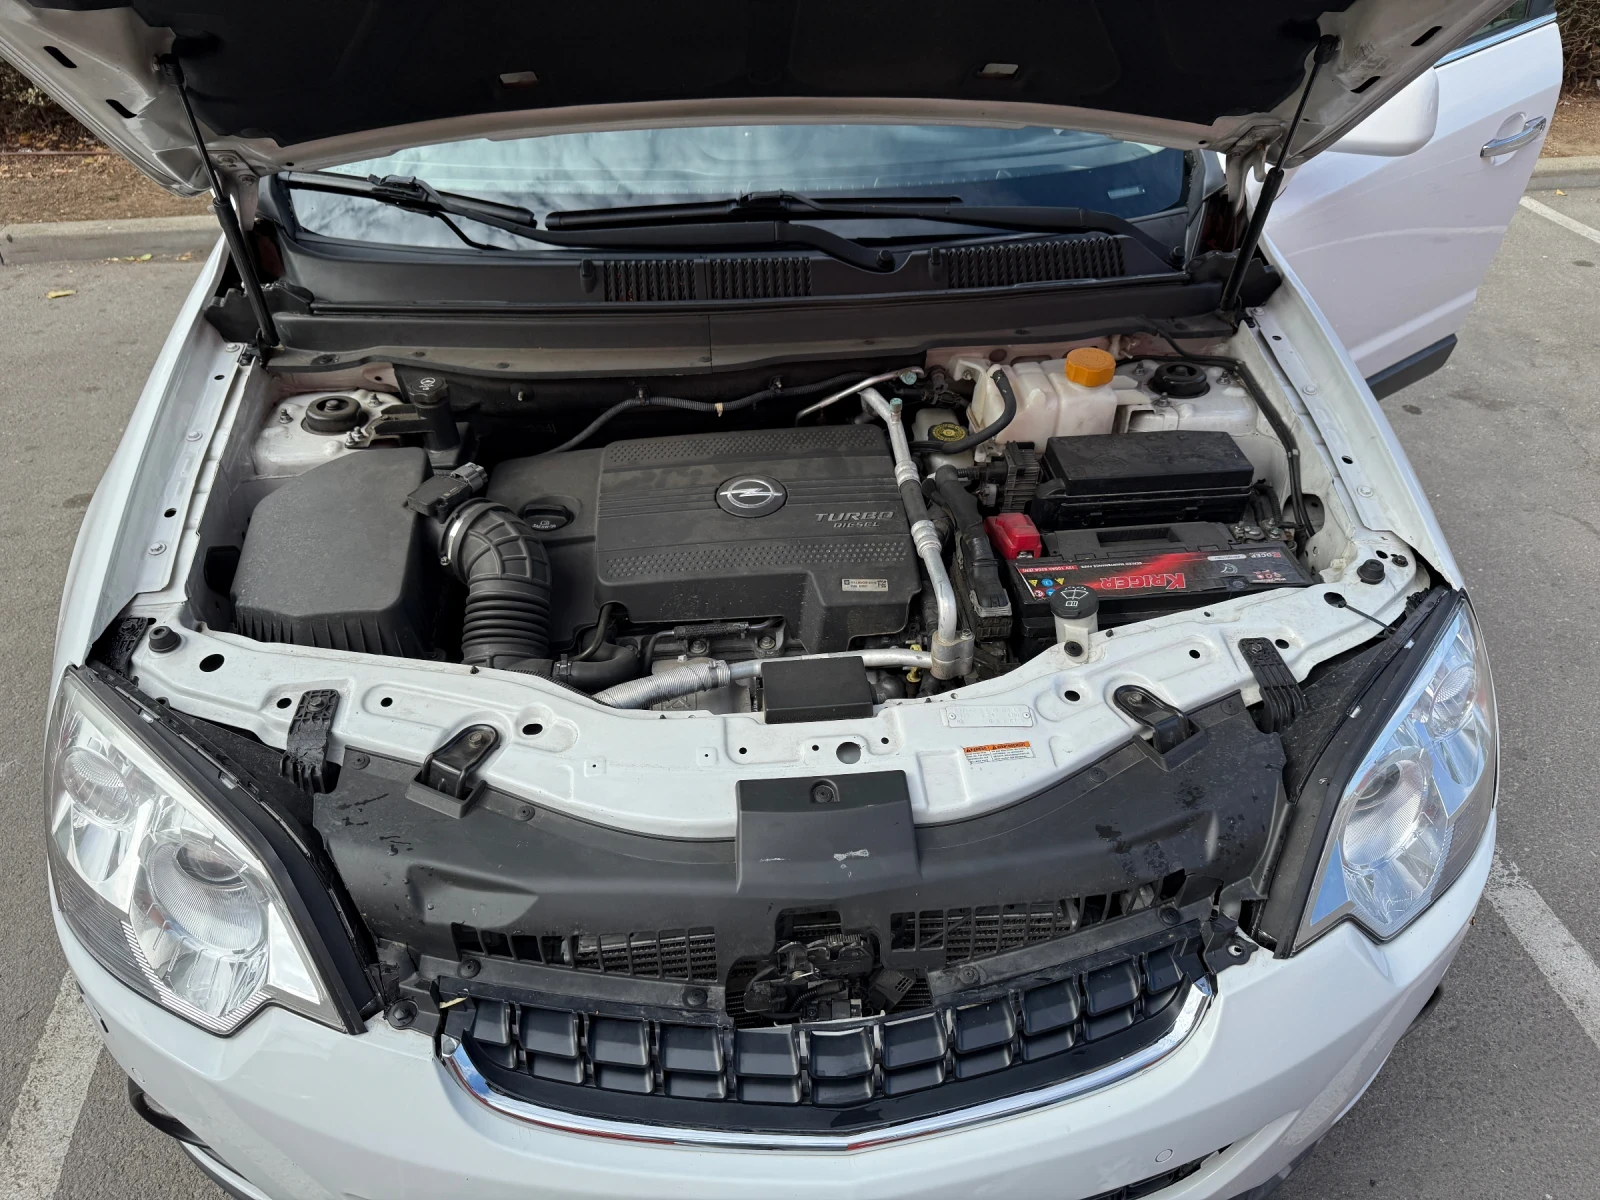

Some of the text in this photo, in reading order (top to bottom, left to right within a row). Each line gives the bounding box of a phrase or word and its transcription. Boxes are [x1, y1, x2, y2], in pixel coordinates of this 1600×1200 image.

[815, 511, 895, 522] TURBO
[833, 521, 880, 529] DIESEL
[1100, 572, 1187, 590] KRIGER
